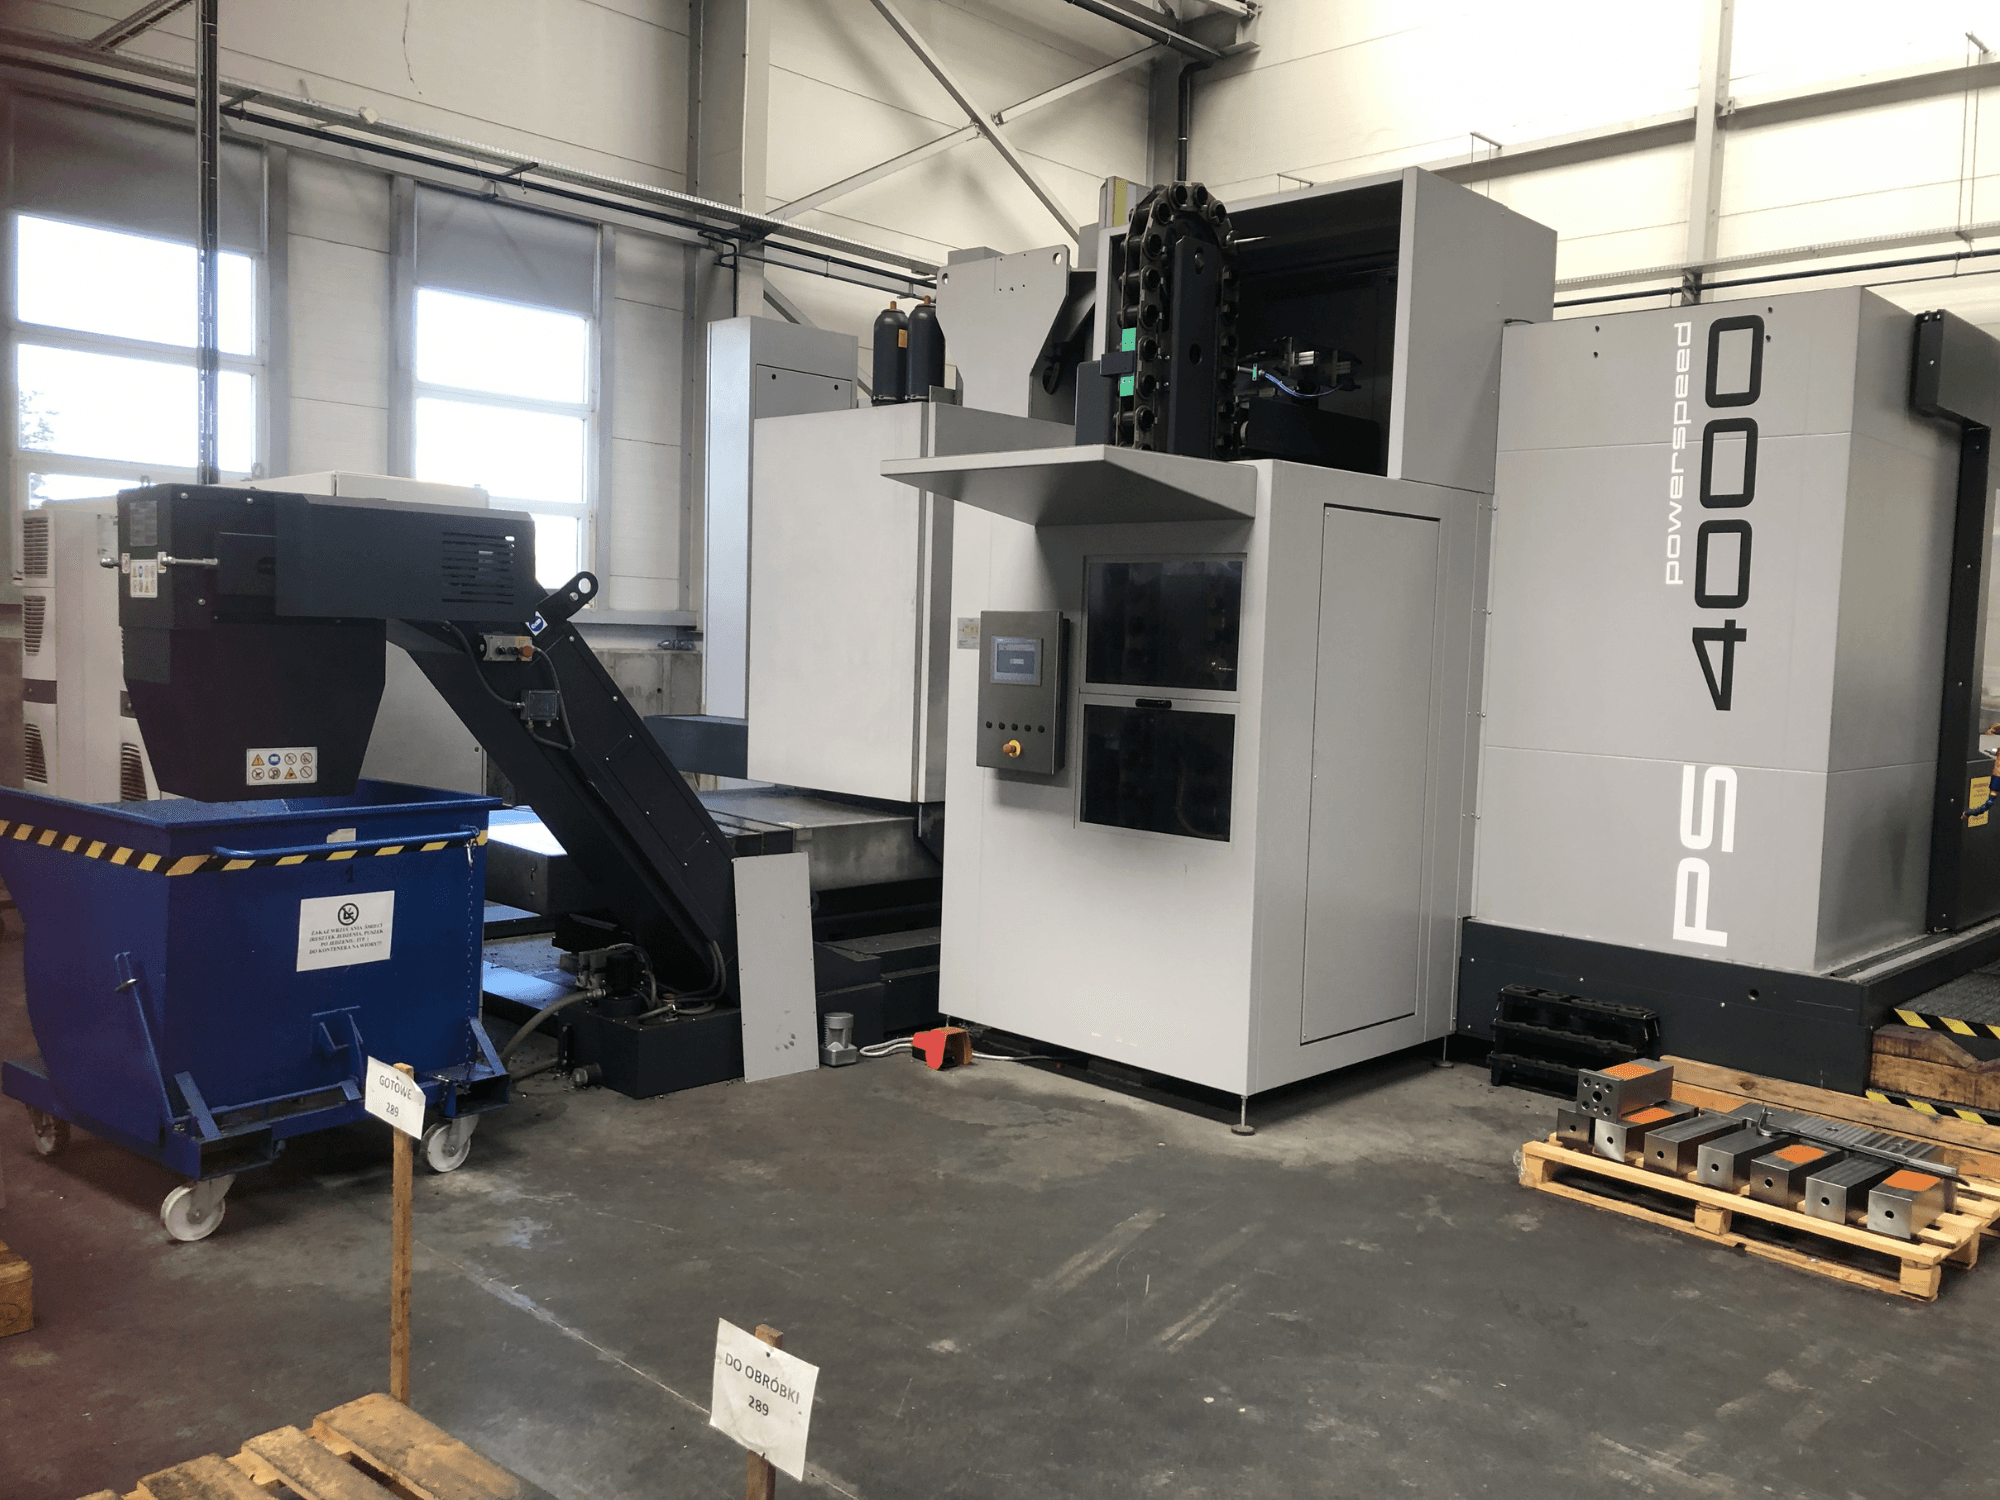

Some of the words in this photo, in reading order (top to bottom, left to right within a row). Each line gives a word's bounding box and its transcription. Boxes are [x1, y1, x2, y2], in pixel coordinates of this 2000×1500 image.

[1665, 321, 1692, 585] powerspeed
[1691, 314, 1765, 711] 4000
[1672, 765, 1738, 947] PS
[379, 1075, 412, 1100] GOTOWE
[386, 1102, 399, 1117] 289
[725, 1352, 742, 1372] DO
[745, 1365, 800, 1404] OBRÓBKI
[748, 1395, 769, 1416] 289
